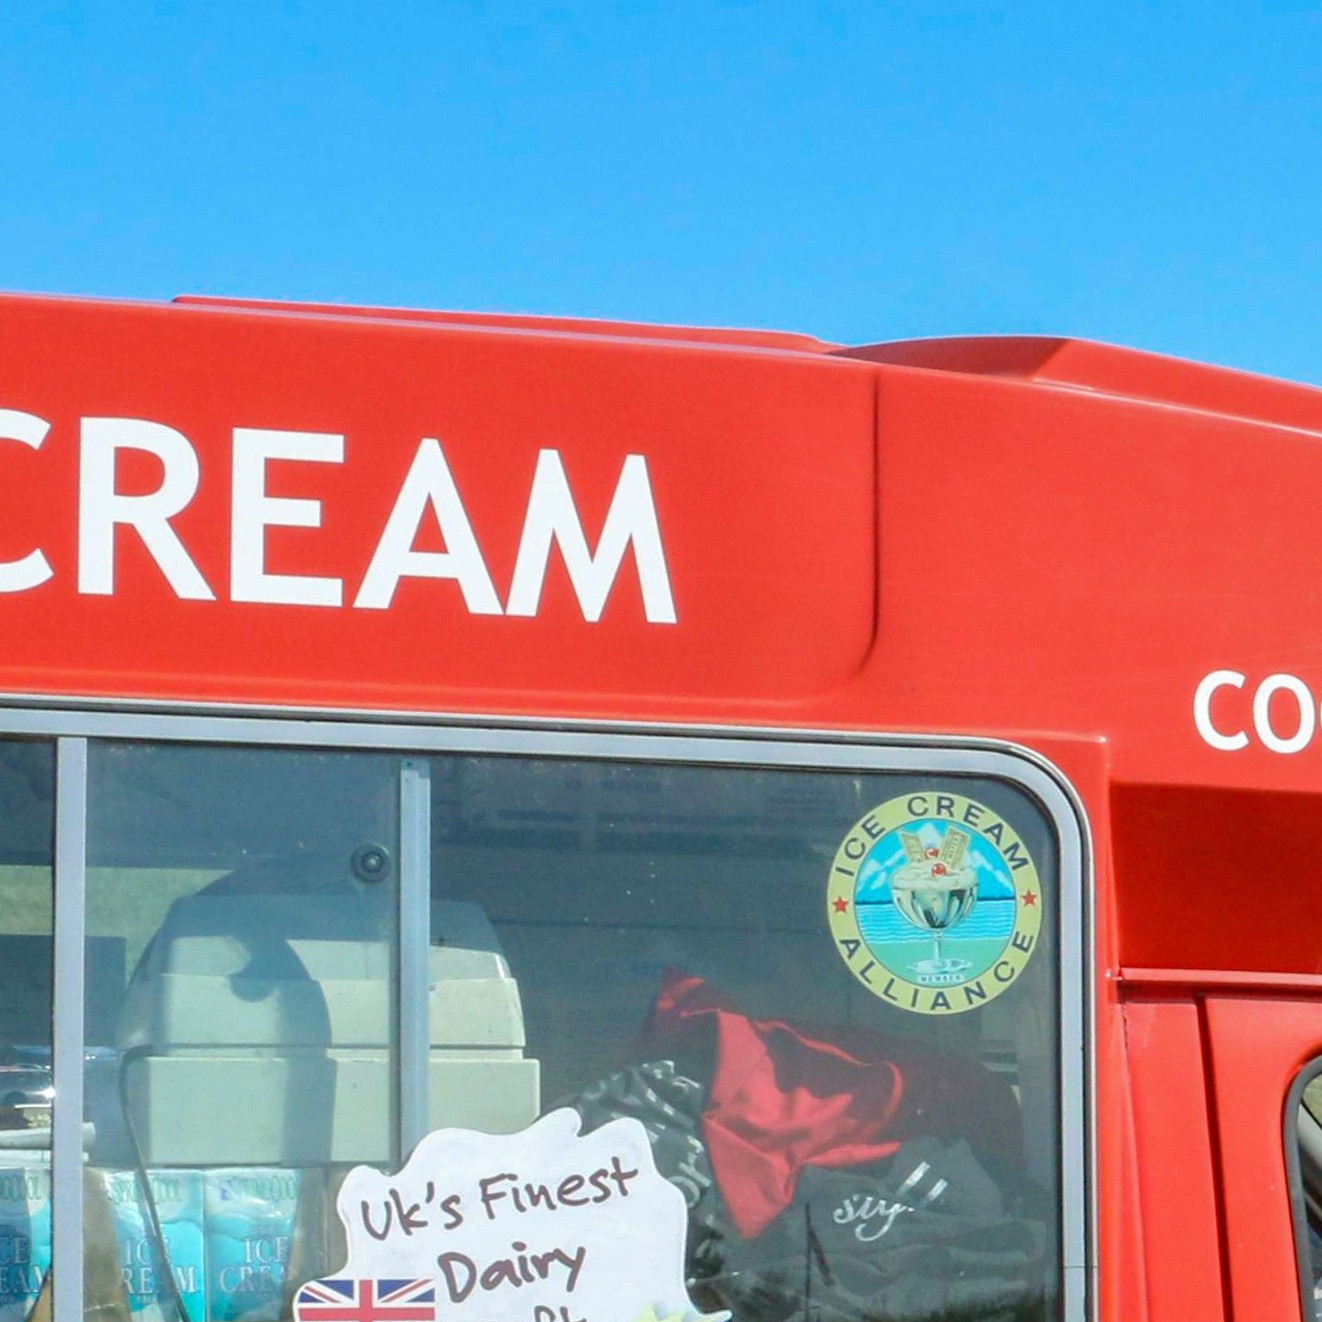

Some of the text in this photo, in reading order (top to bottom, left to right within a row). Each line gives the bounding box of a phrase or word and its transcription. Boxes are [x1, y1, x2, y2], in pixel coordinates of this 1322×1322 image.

[835, 796, 1029, 877] ICE CREAM
[840, 931, 1035, 1011] ALLIANCE
[479, 1156, 640, 1221] Finest
[438, 1242, 587, 1304] Dairy
